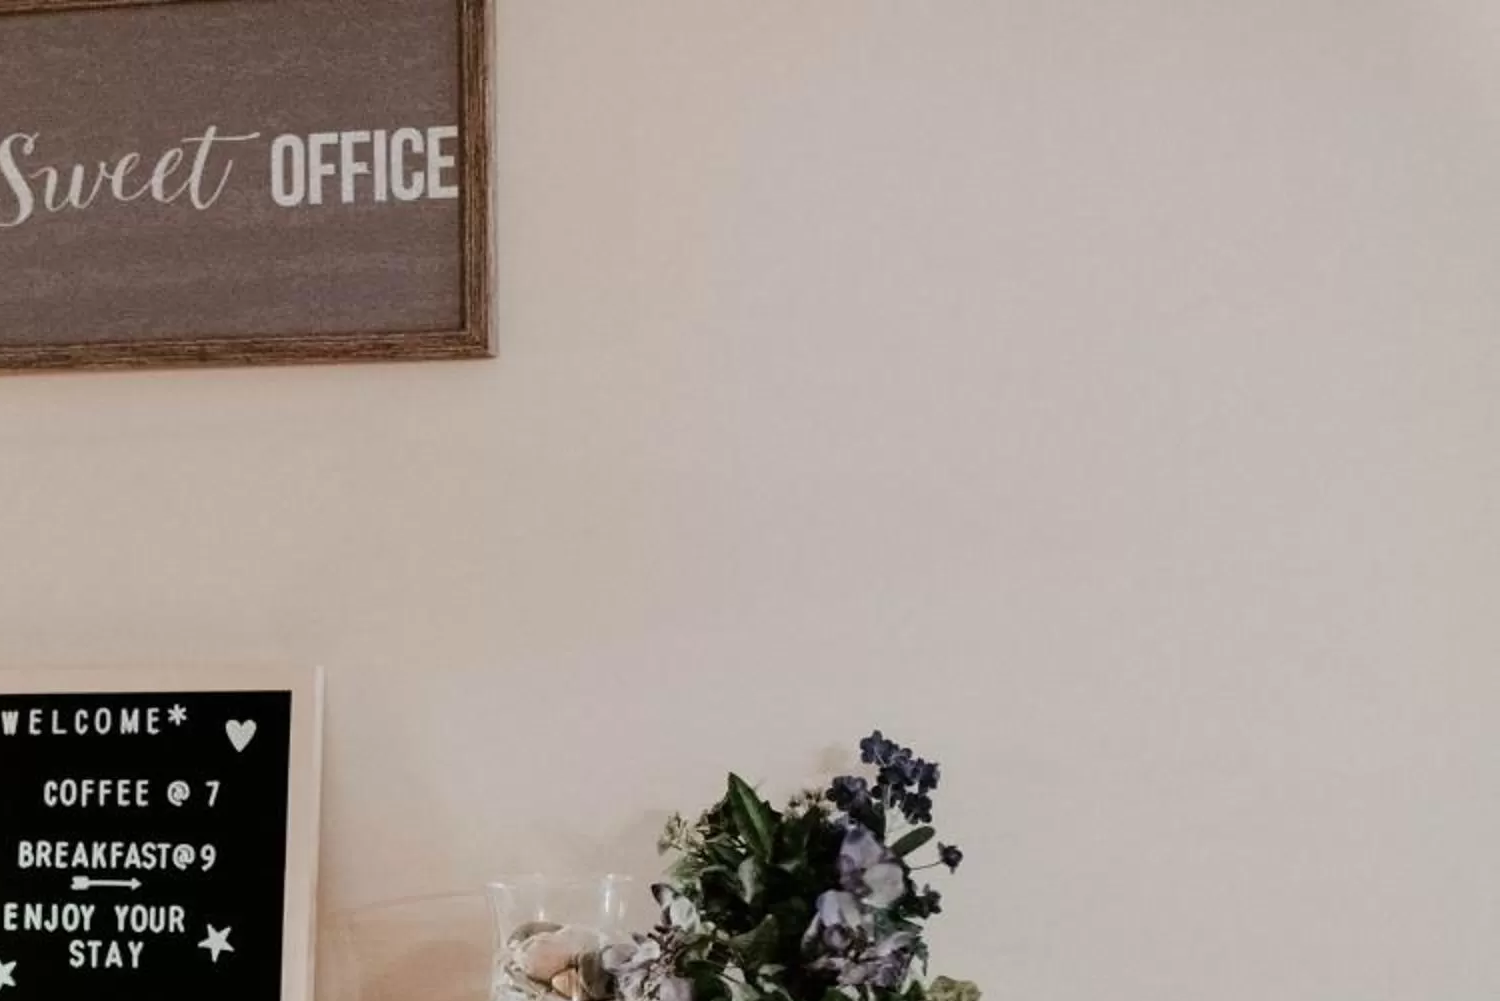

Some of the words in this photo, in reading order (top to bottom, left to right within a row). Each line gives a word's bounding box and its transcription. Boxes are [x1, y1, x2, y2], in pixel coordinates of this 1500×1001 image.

[271, 126, 459, 207] OFFICE
[43, 779, 149, 807] COFFEE
[205, 780, 221, 807] 7
[3, 903, 95, 932] ENJOY
[114, 904, 185, 933] YOUR
[68, 940, 144, 968] STAY
